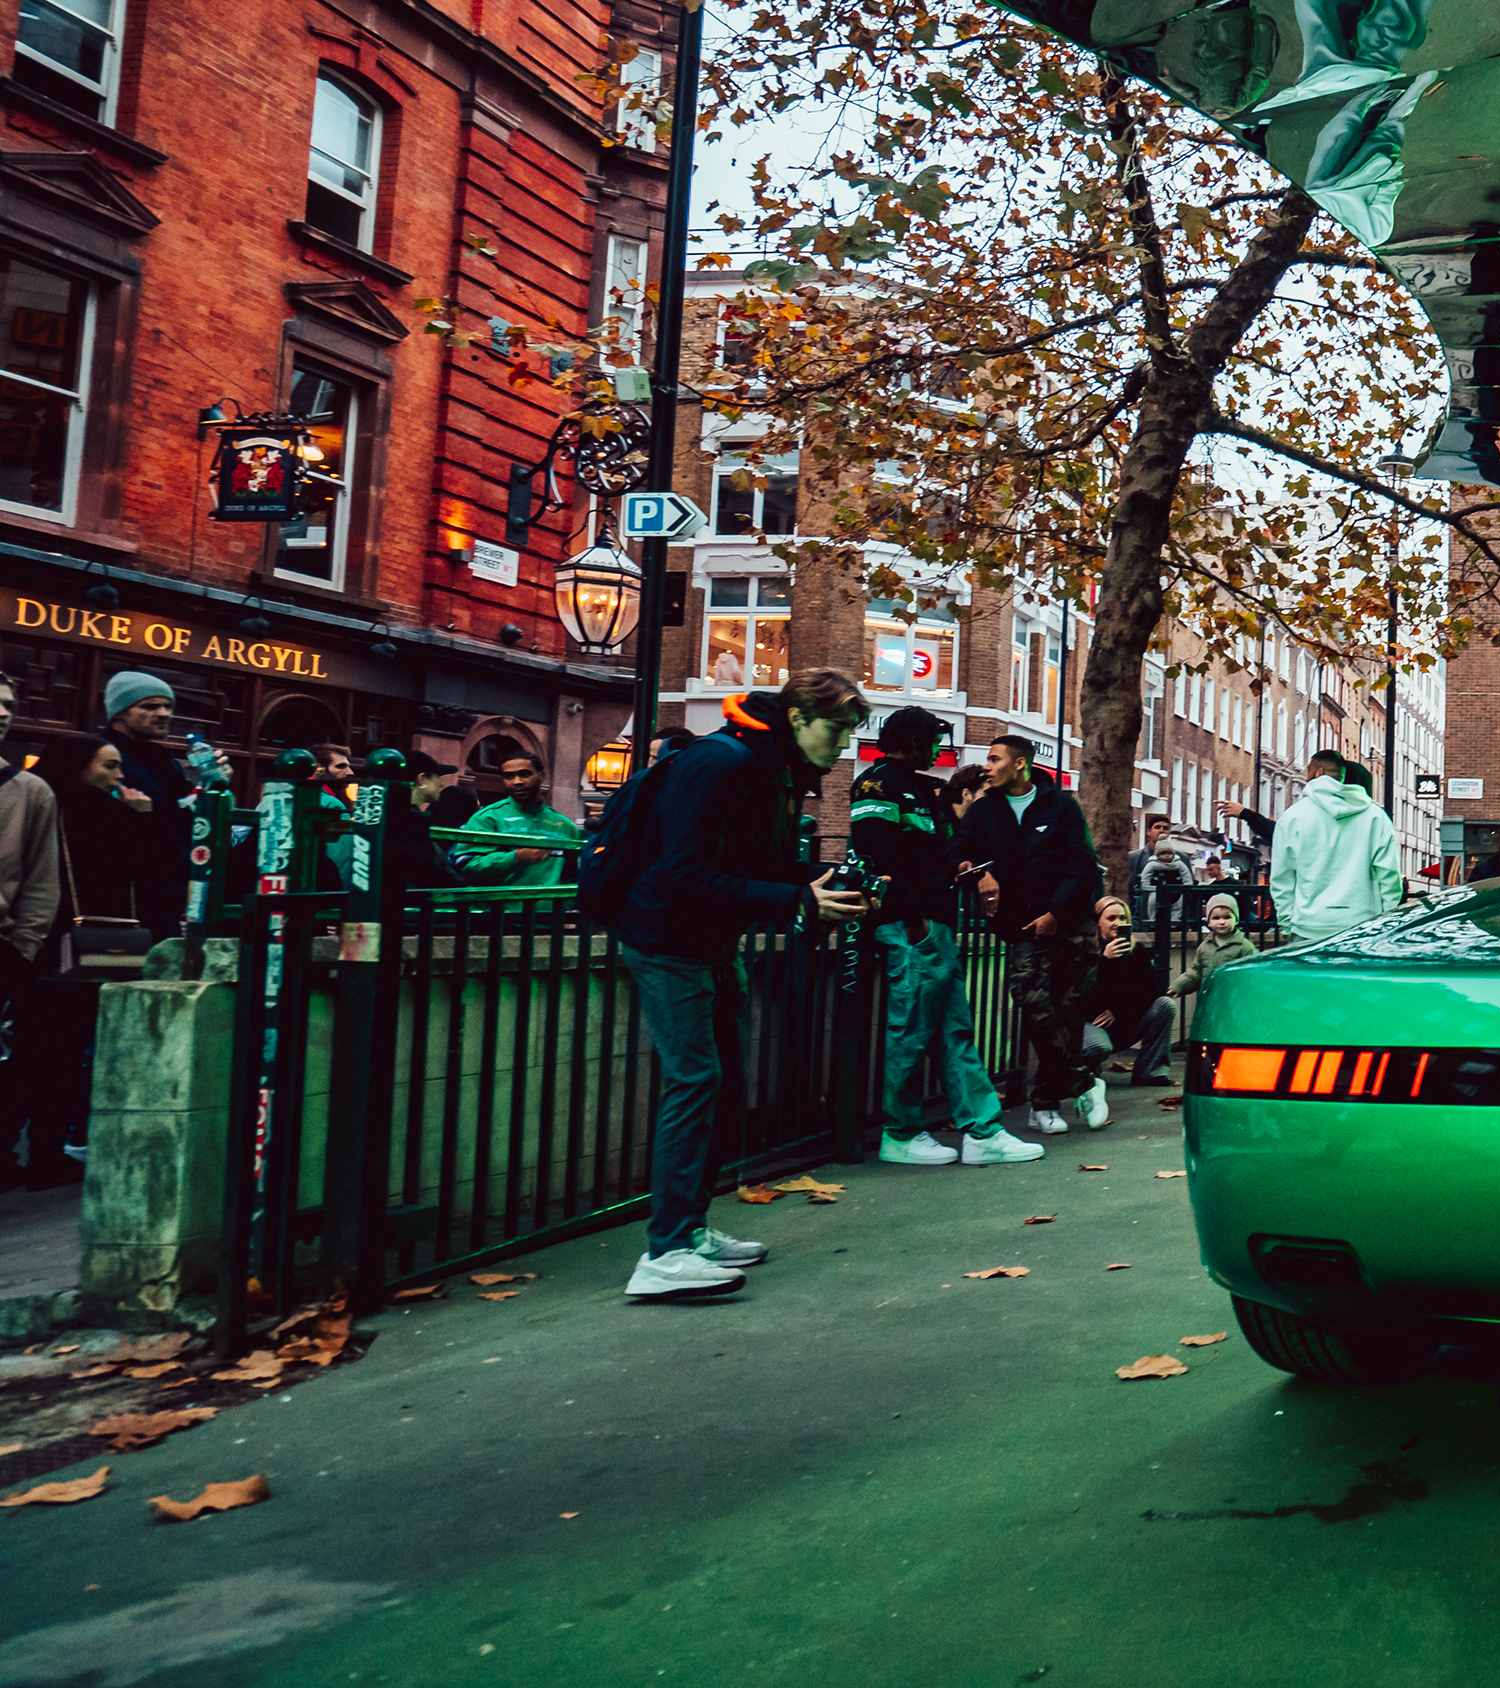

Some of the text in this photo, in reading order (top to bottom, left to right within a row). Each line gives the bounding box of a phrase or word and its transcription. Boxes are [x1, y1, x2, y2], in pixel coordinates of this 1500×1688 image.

[633, 500, 658, 529] P
[474, 555, 501, 570] STREET
[475, 544, 504, 560] BREWER
[14, 597, 328, 679] DUKE OF ARGYLL
